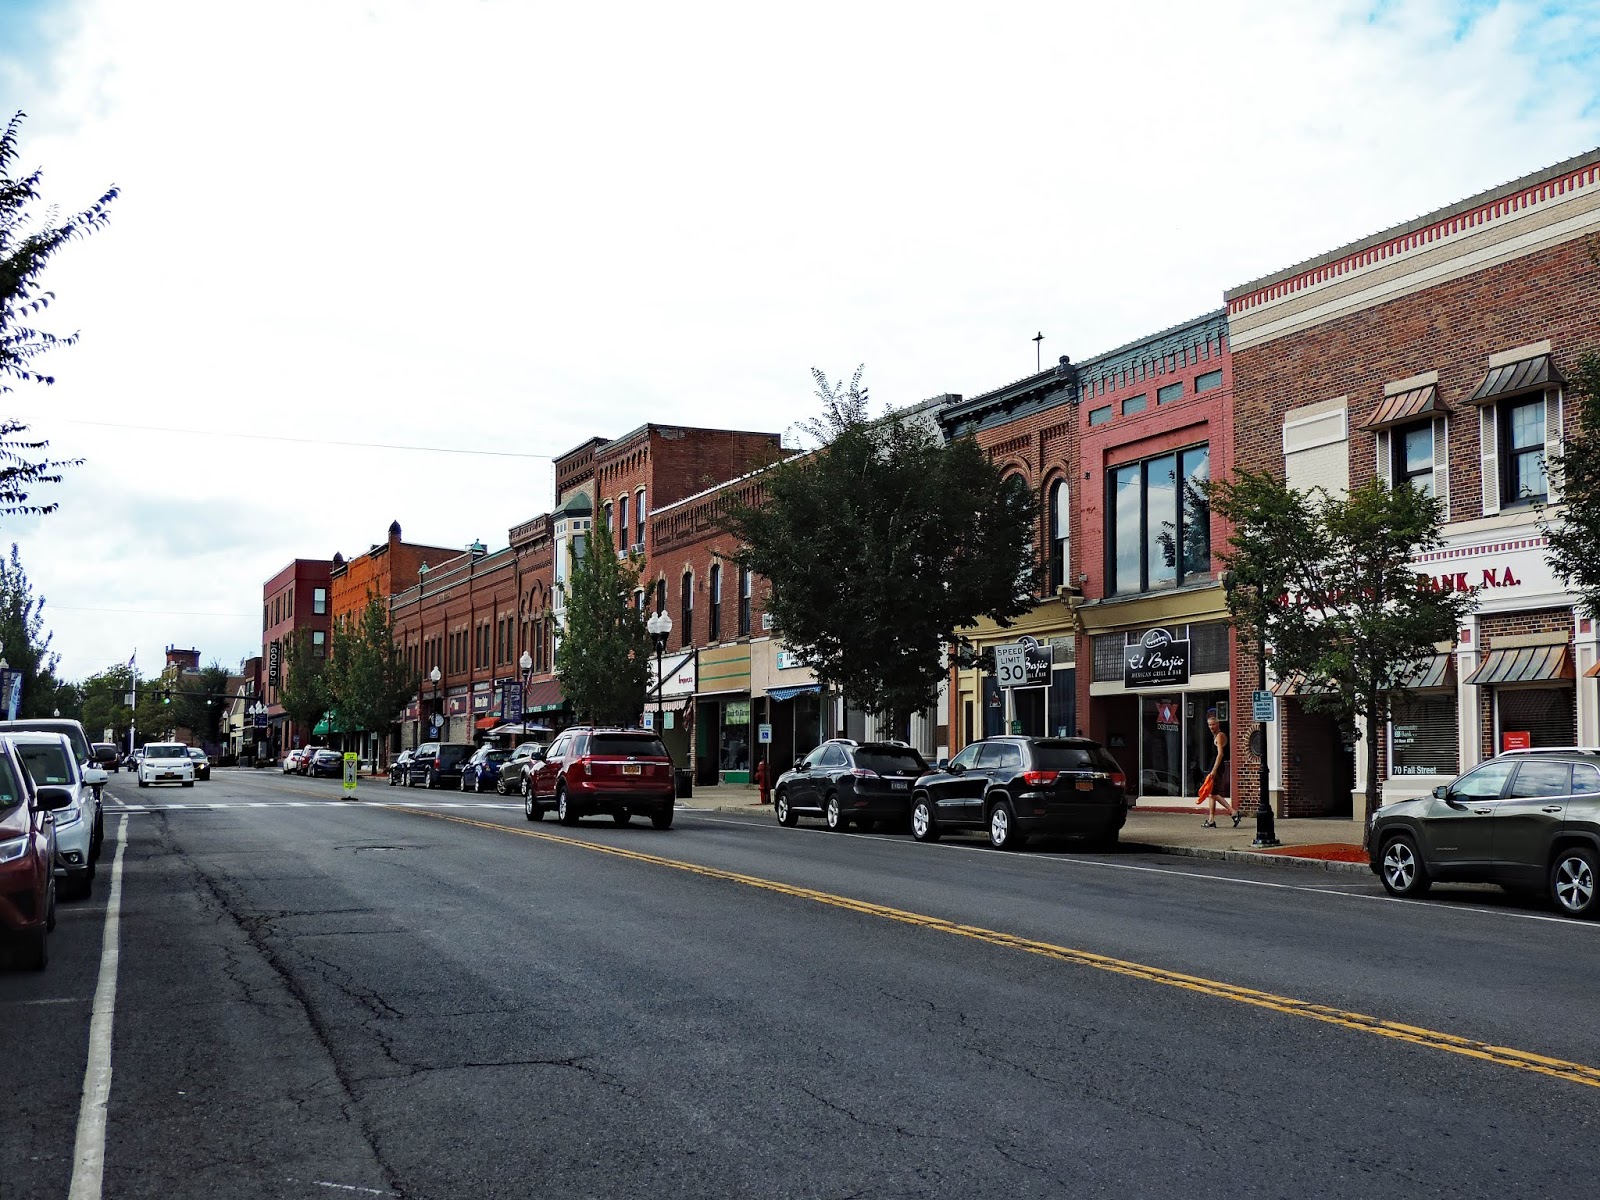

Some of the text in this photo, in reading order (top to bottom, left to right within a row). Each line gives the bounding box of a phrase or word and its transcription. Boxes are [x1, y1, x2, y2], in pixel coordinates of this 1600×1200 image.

[1482, 566, 1521, 589] N.A.
[997, 648, 1022, 656] SPEED
[1001, 656, 1020, 664] LIMIT
[1128, 654, 1144, 670] El
[1000, 665, 1024, 680] 30
[1394, 766, 1437, 774] 70 Fall Street
